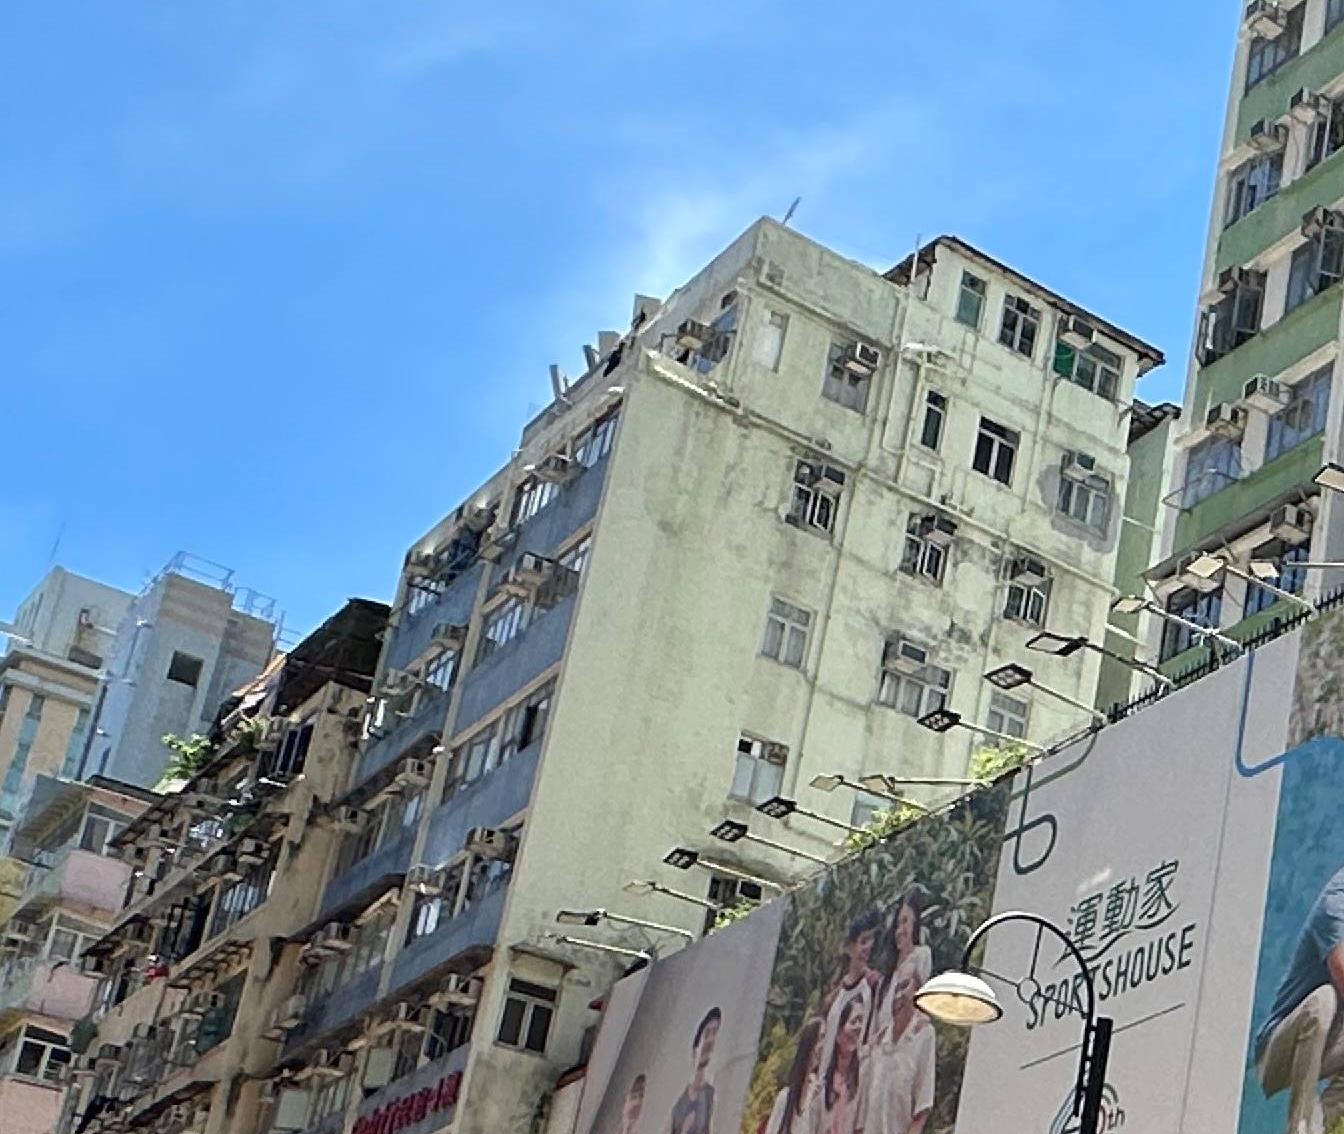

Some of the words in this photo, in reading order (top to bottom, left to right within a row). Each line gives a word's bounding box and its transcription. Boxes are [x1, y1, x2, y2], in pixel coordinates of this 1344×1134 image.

[1054, 860, 1180, 966] 運動家
[1026, 923, 1196, 1030] SPORTSHOUSE
